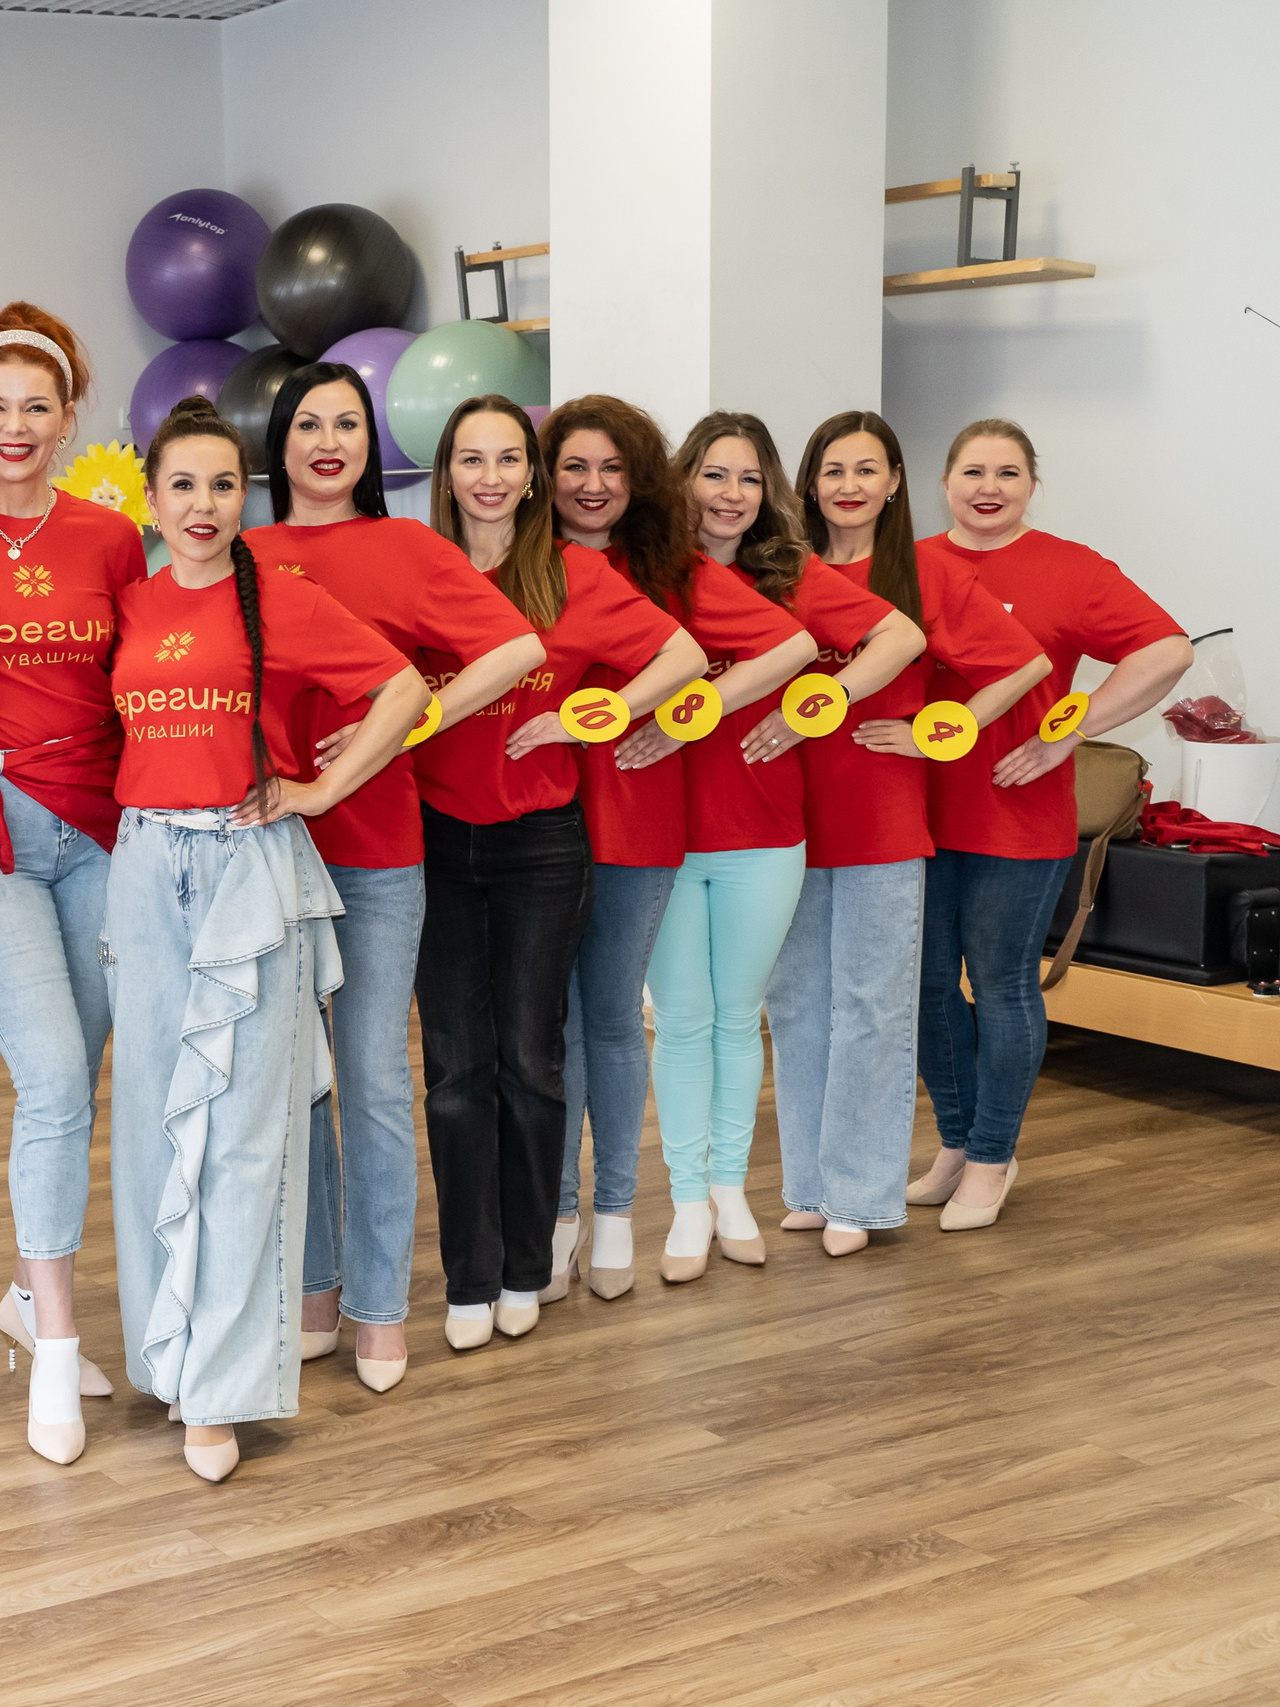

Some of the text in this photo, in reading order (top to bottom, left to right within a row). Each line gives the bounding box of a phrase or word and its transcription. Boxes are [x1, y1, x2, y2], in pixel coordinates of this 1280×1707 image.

[572, 698, 618, 730] 10
[672, 693, 705, 724] 8
[1049, 705, 1078, 732] 2
[927, 721, 964, 743] 4
